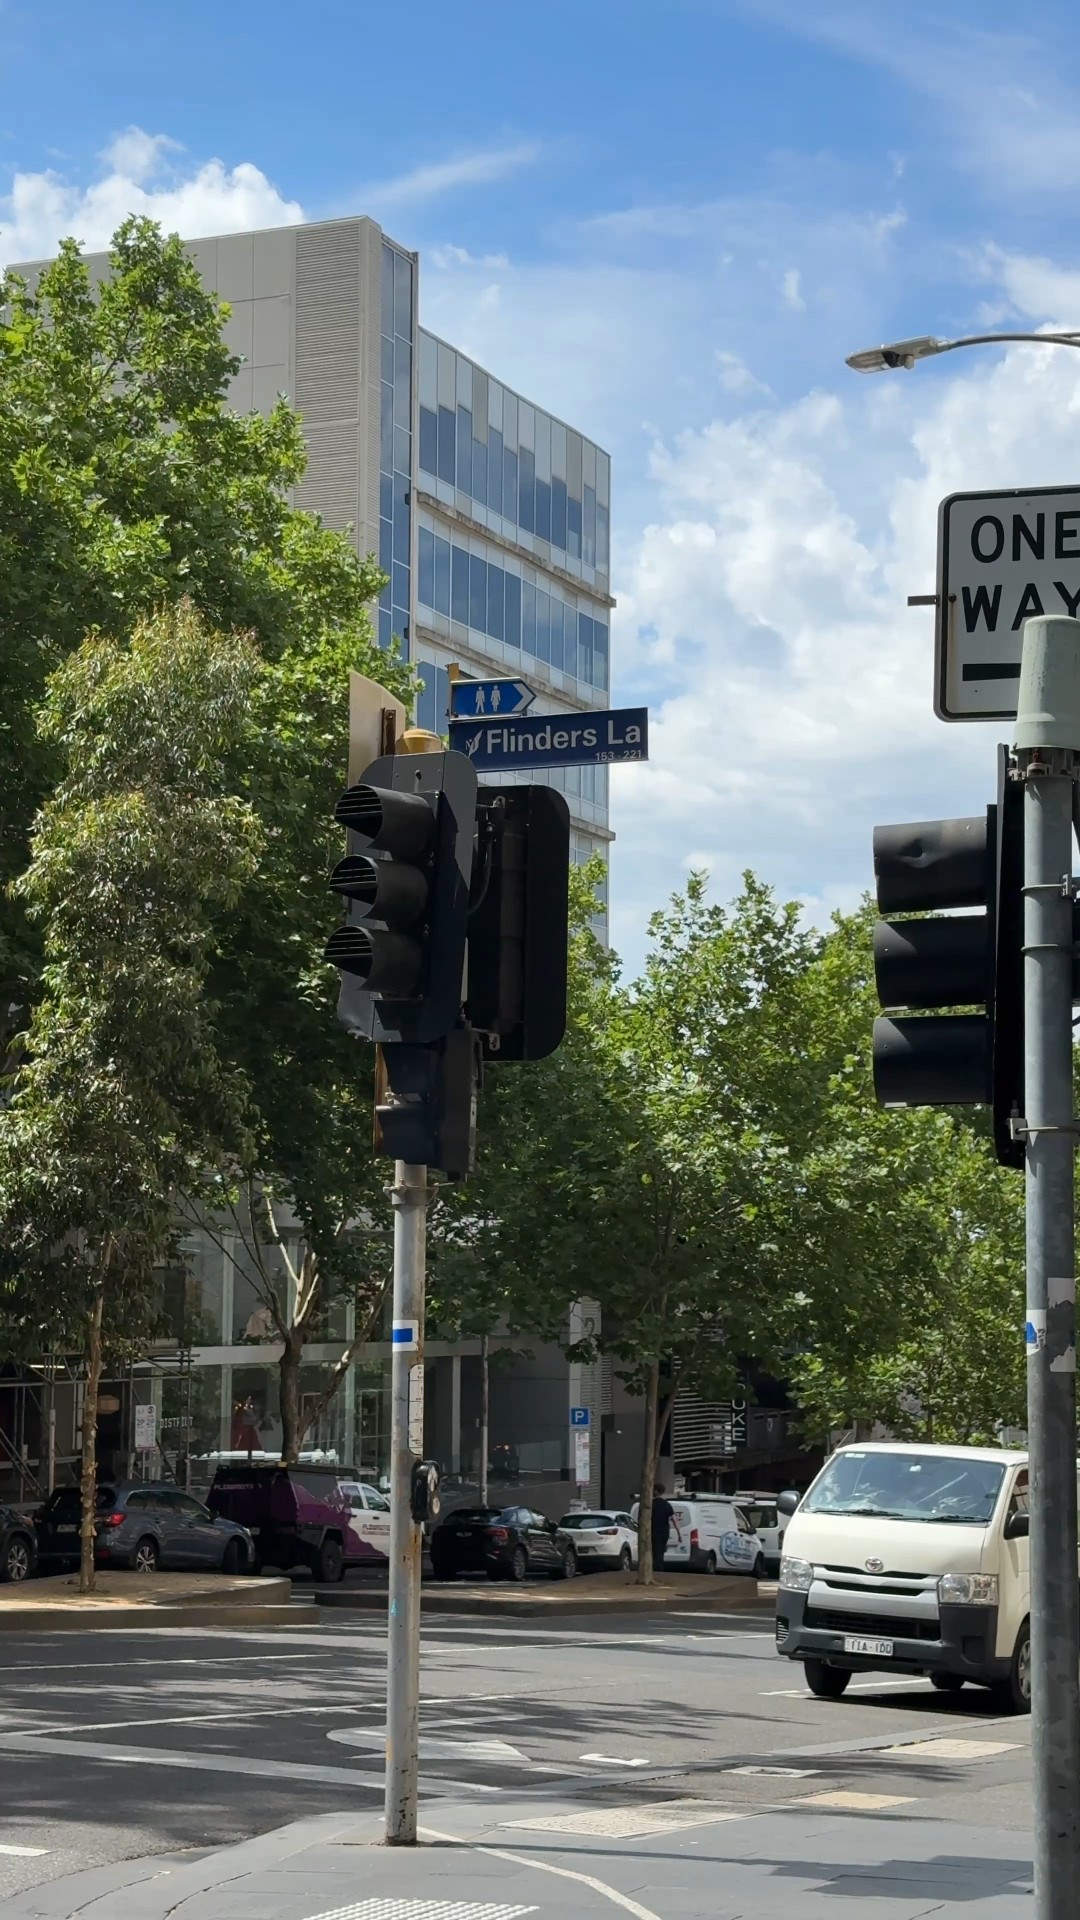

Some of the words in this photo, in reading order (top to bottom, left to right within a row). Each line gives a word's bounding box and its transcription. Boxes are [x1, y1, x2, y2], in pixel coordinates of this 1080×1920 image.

[970, 511, 1080, 563] ONE
[486, 725, 598, 754] Flinders
[607, 720, 641, 745] La
[595, 751, 614, 761] 153
[623, 750, 642, 759] 221
[575, 1411, 584, 1422] P
